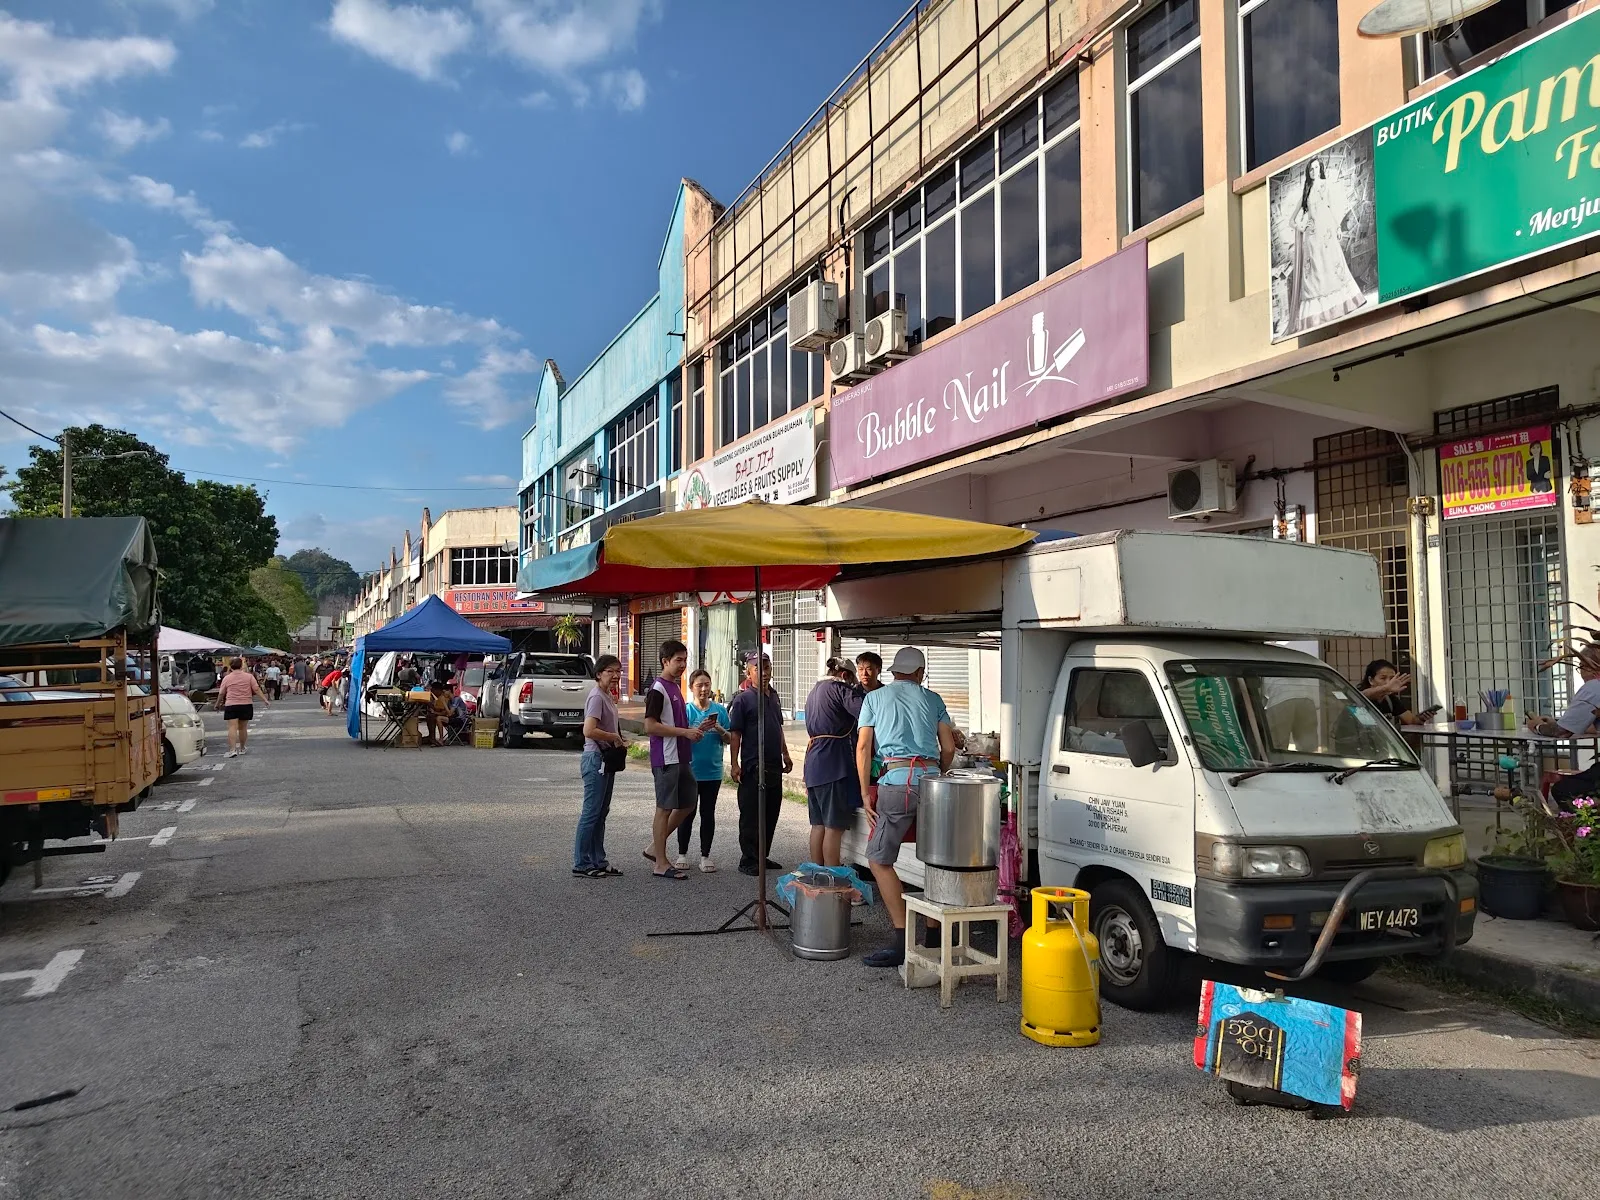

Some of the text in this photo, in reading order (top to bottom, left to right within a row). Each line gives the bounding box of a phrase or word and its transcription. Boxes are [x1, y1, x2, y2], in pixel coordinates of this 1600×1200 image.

[1377, 101, 1436, 147] BUTIK
[857, 360, 1011, 459] Bubble Nail
[763, 433, 772, 444] DAN
[772, 417, 803, 439] BUAH-BUAHAN
[1453, 442, 1474, 456] SALE
[1519, 431, 1529, 444] 租
[735, 447, 775, 482] BAI JIA
[713, 481, 748, 506] VEGETABLES
[748, 479, 753, 494] &
[754, 469, 776, 491] FRUITS
[777, 458, 805, 483] SUPPLY
[1443, 450, 1525, 503] 016-555 9773
[1469, 502, 1496, 513] CHONG
[454, 591, 491, 602] RESTORAN
[492, 591, 504, 601] SIN
[1088, 796, 1126, 809] CHIN JAW YUAN
[1093, 812, 1102, 821] TMN
[1109, 845, 1112, 853] 2
[1112, 847, 1127, 857] ORANG
[1127, 849, 1145, 860] PEKERJA
[1145, 853, 1161, 863] SENDIRI
[1153, 879, 1166, 891] BDM
[1153, 890, 1166, 901] BTM
[1360, 908, 1418, 930] WEY 4473
[1228, 1023, 1274, 1043] DOG
[1241, 1036, 1272, 1061] HQ
